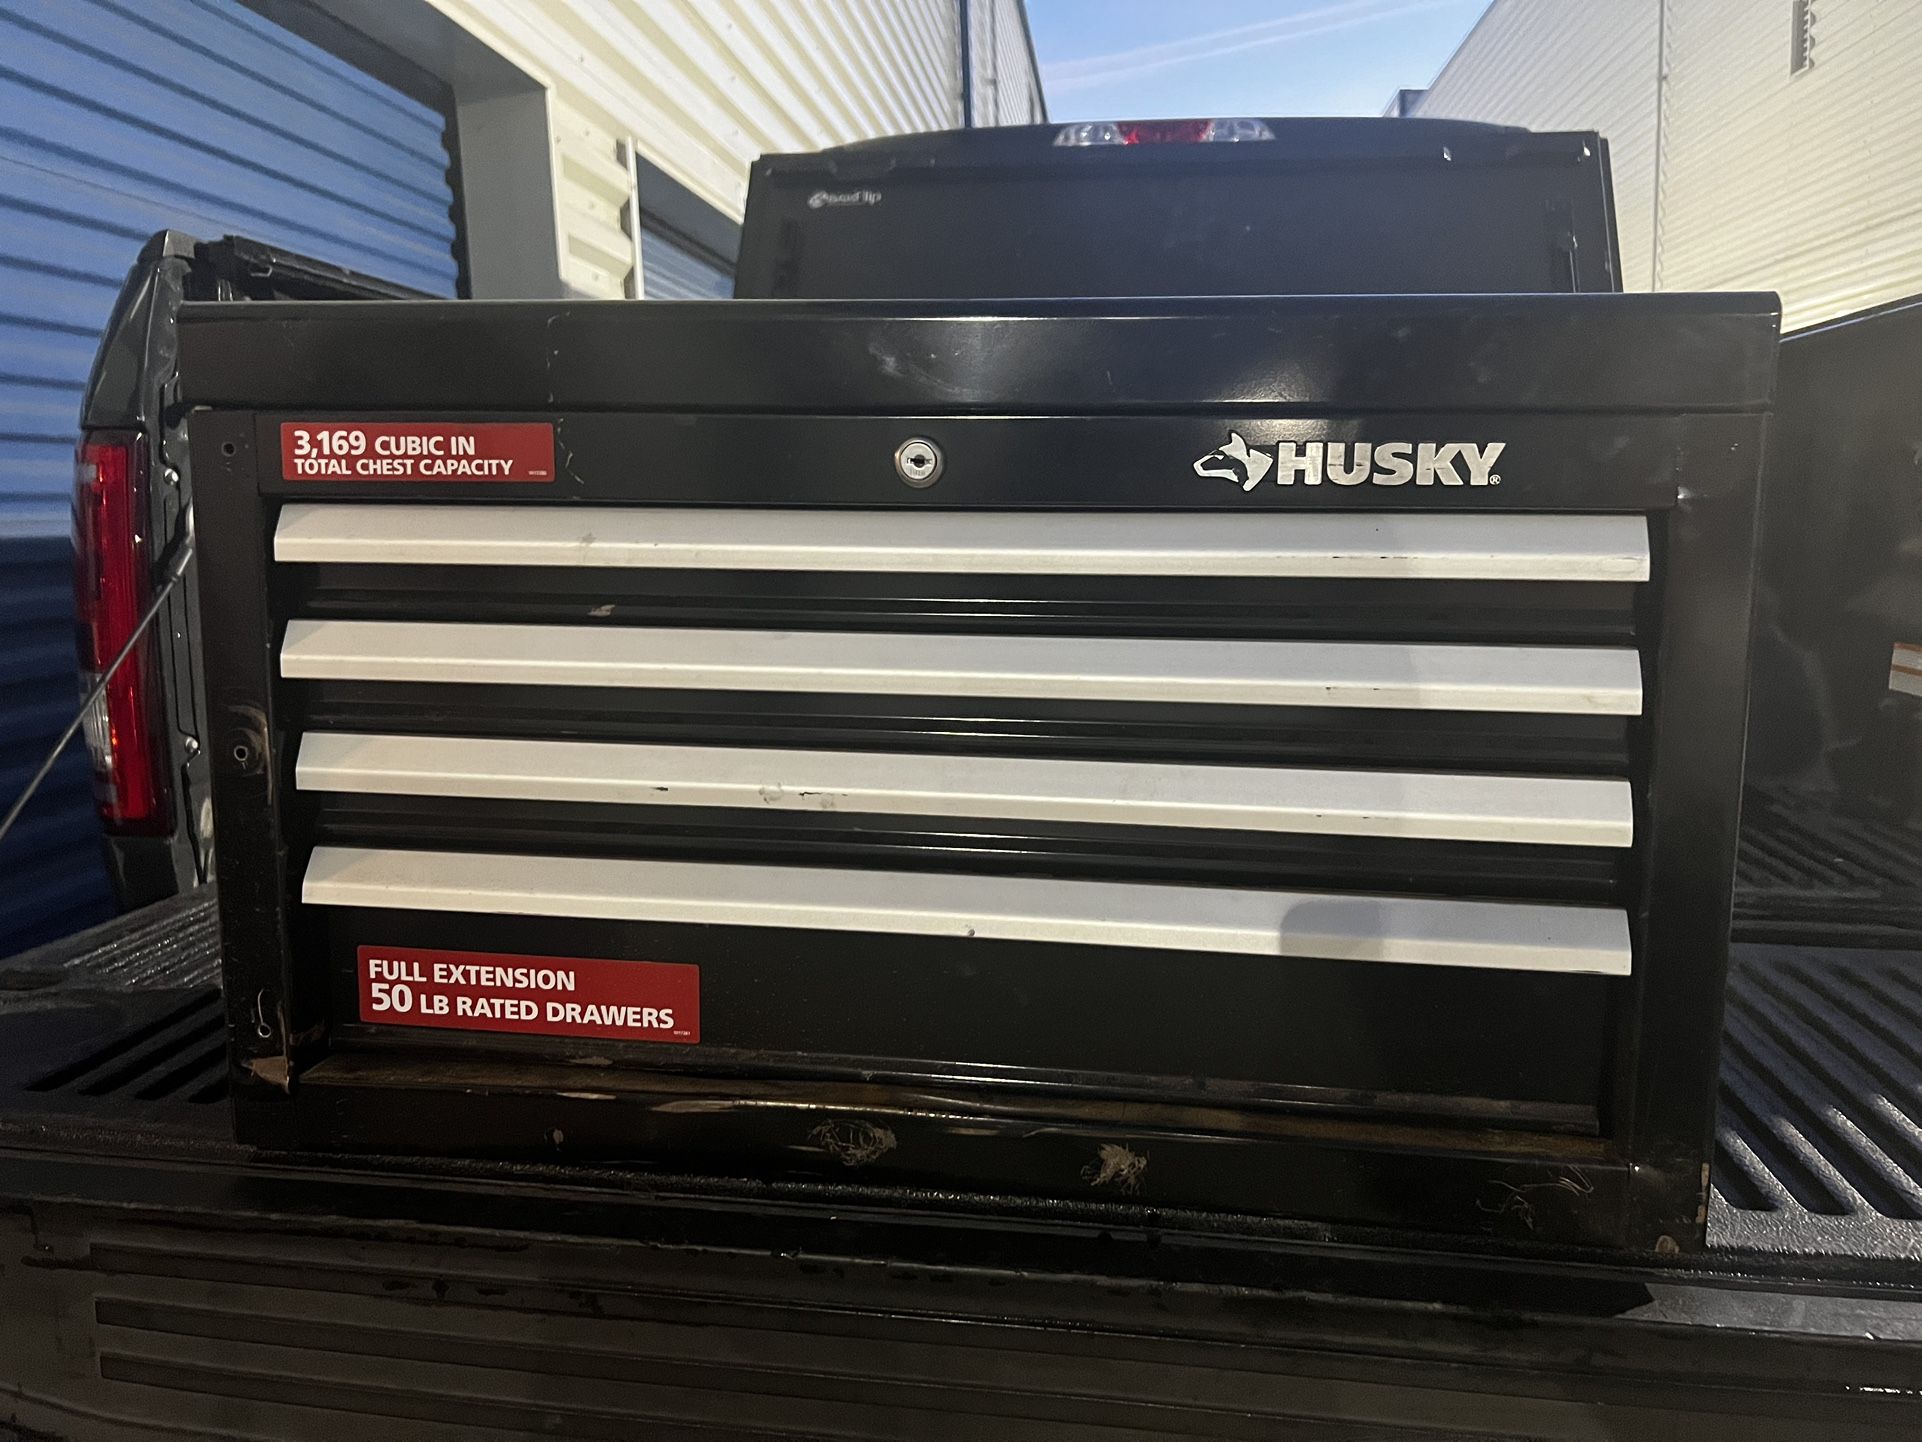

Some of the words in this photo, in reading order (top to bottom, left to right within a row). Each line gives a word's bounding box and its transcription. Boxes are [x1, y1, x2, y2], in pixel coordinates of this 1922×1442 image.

[294, 430, 367, 458] 3,169
[374, 435, 444, 456] CUBIC
[450, 435, 476, 456] IN
[294, 458, 352, 475] TOTAL
[355, 458, 414, 475] CHEST
[418, 459, 513, 475] CAPACITY
[368, 959, 427, 982] FULL
[432, 963, 576, 991] EXTENSION
[371, 982, 413, 1013] 50
[419, 994, 450, 1015] LB
[456, 996, 539, 1021] RATED
[545, 1001, 675, 1029] DRAWERS
